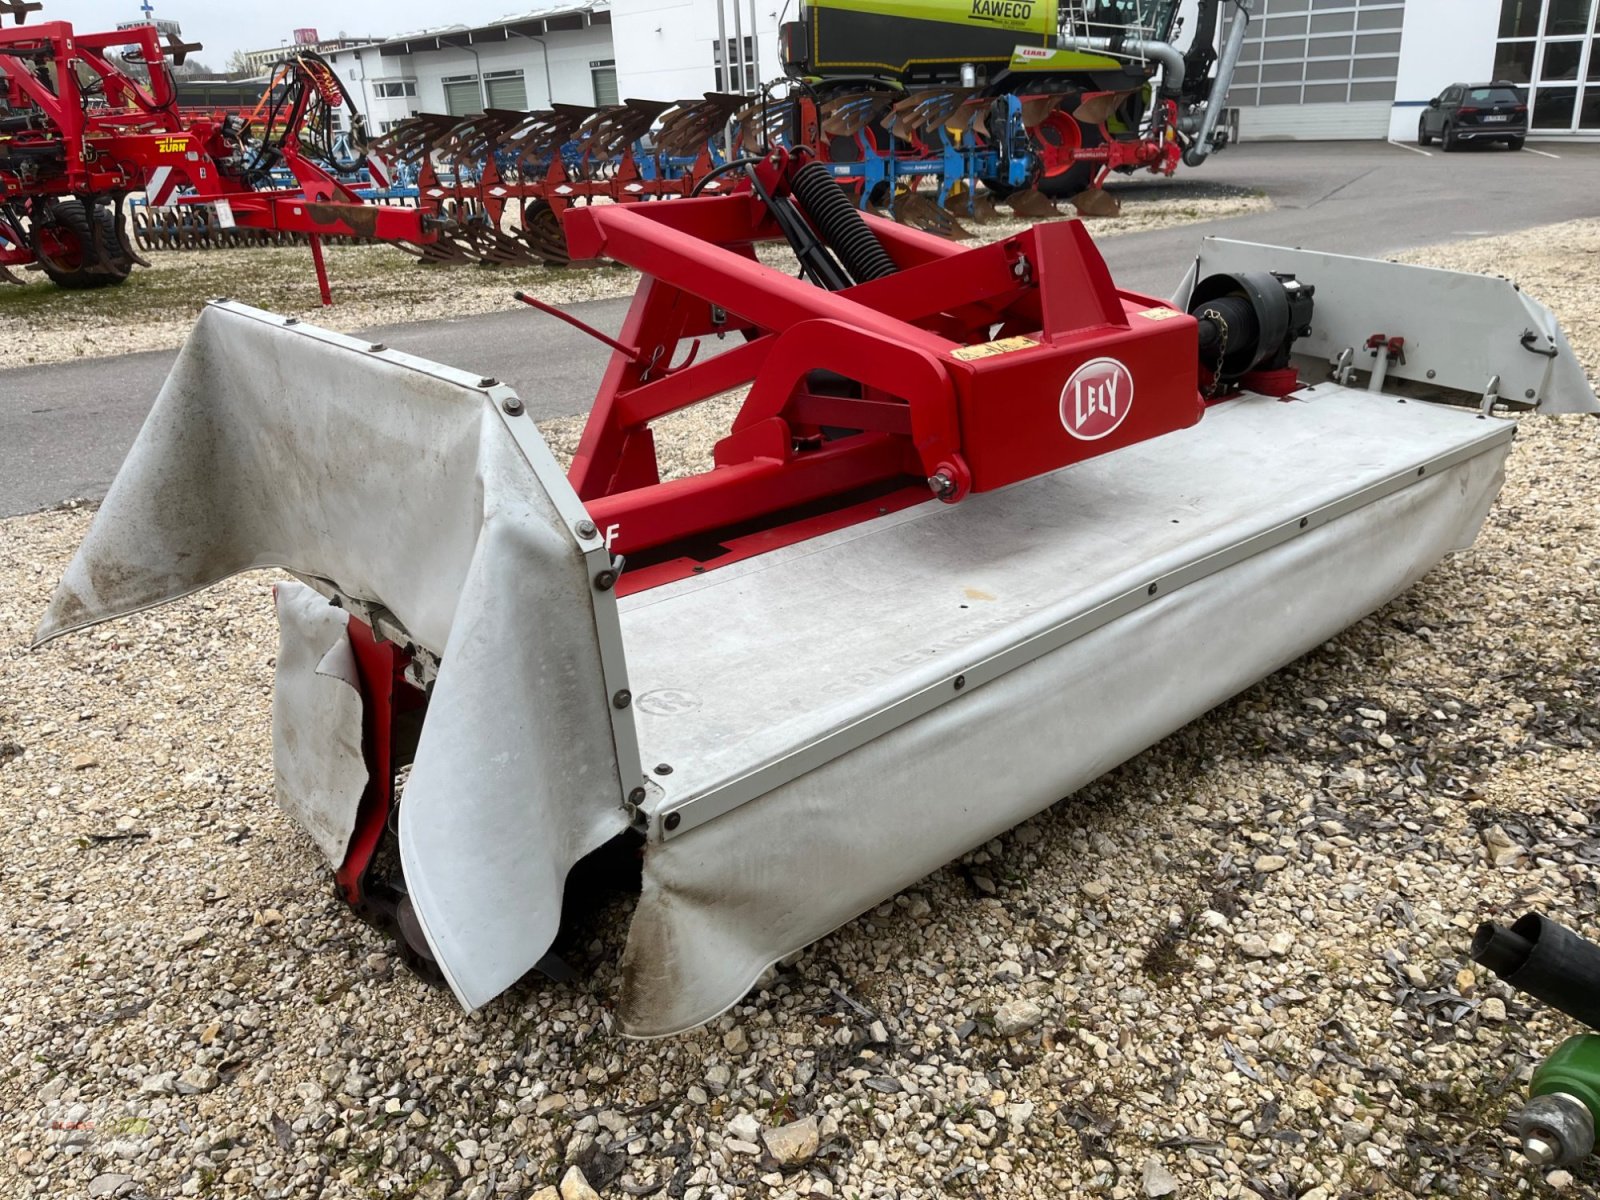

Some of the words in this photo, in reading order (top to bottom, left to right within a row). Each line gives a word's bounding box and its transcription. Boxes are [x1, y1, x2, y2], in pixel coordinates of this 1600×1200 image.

[972, 0, 1031, 19] KAWECO
[158, 137, 187, 152] ZÜRN
[1075, 369, 1119, 430] LELY
[605, 523, 620, 551] F
